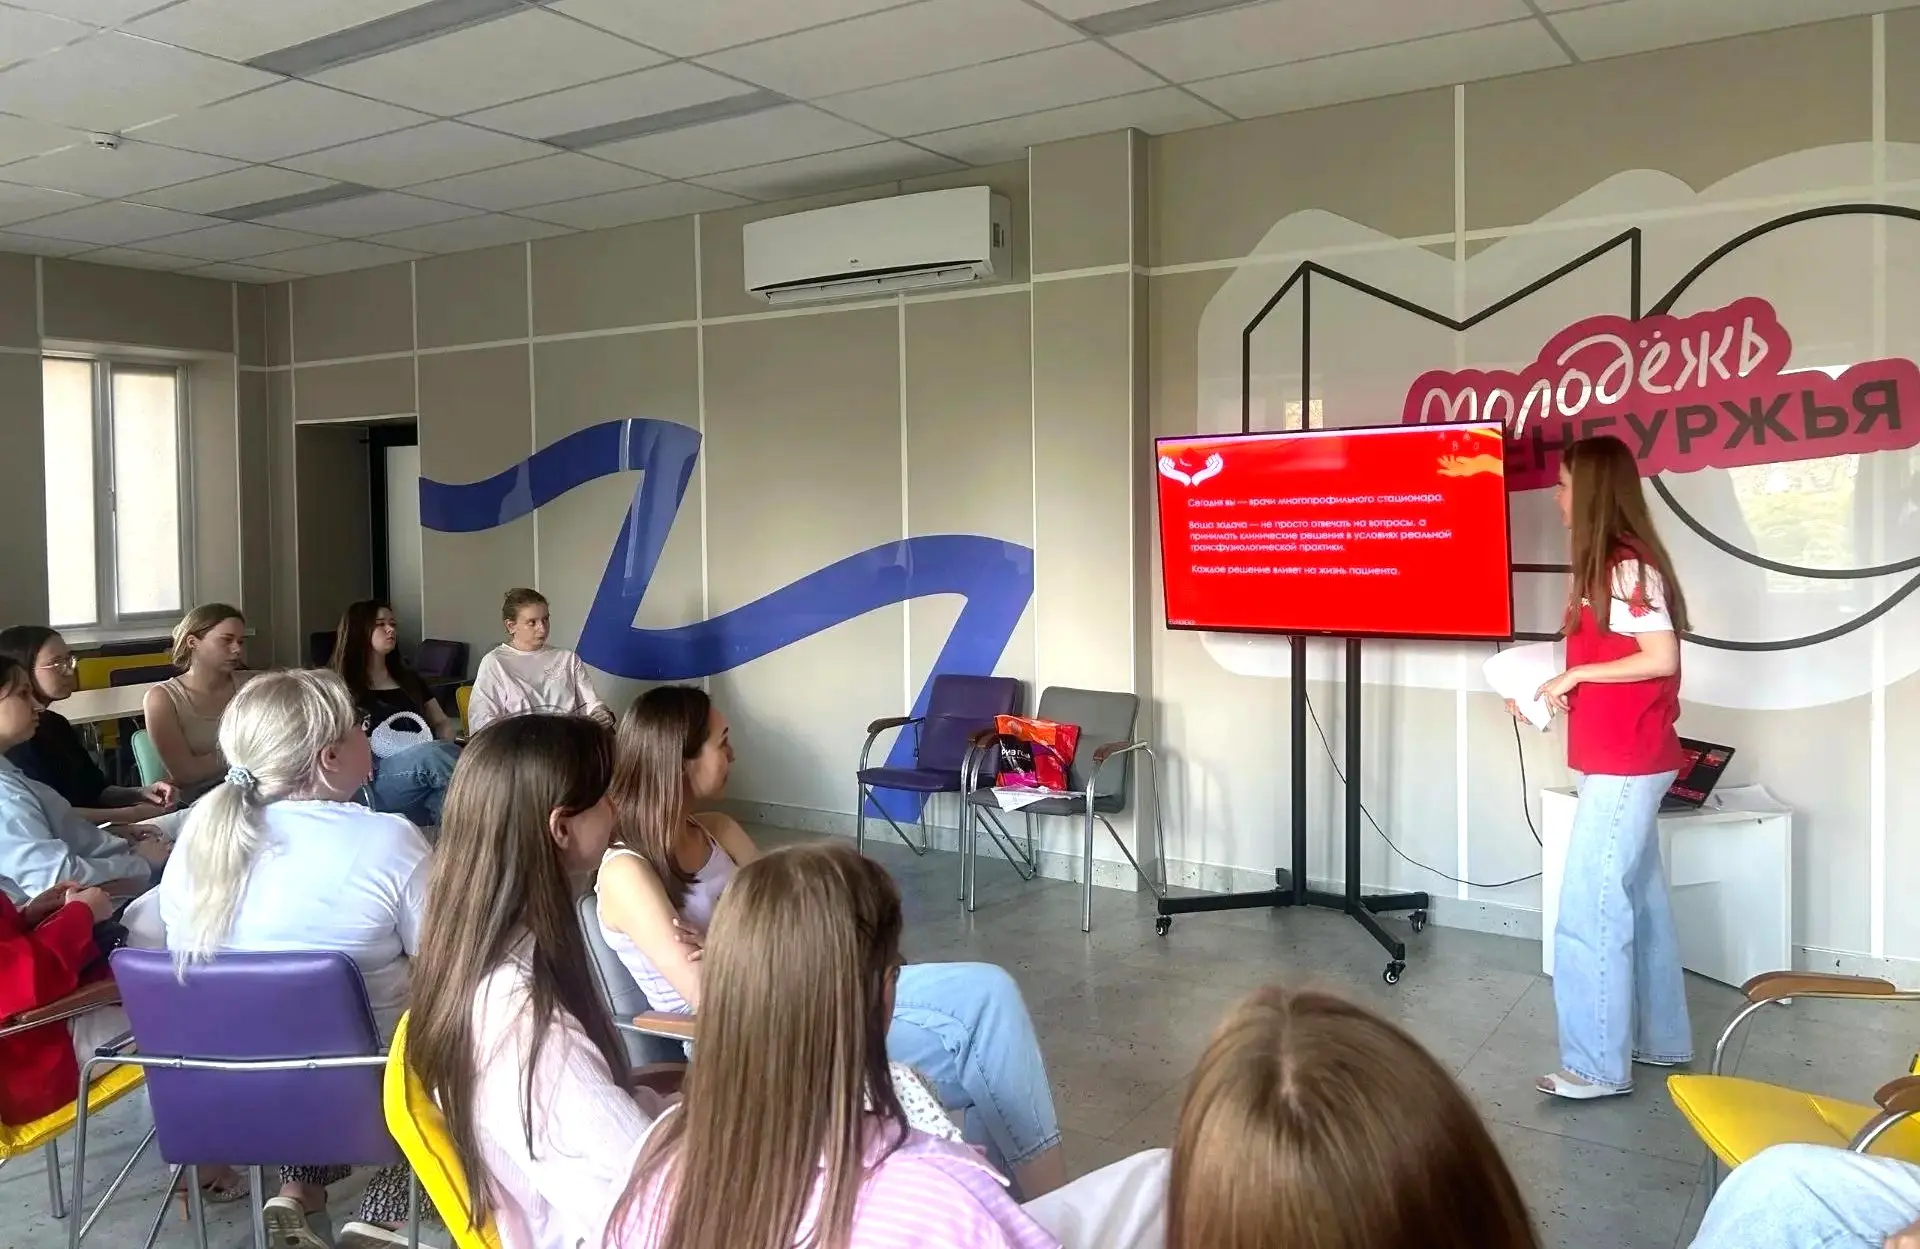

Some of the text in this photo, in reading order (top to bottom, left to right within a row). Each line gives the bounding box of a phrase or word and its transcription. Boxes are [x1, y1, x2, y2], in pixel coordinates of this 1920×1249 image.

[1188, 498, 1224, 508] Сегодня
[1249, 498, 1277, 507] врачи
[1279, 495, 1375, 506] многопрофильного
[1377, 493, 1444, 504] стационара.
[1188, 520, 1215, 529] Ваша
[1216, 521, 1248, 530] задача
[1261, 521, 1272, 529] не
[1275, 520, 1309, 530] просто
[1311, 519, 1351, 528] отвечать
[1354, 519, 1366, 527] на
[1190, 528, 1452, 541] принимать клинические решения в условиях реальной
[1191, 542, 1345, 553] трансфузиологической практики.
[1192, 565, 1226, 574] Каждое
[1228, 566, 1271, 576] решение
[1273, 566, 1301, 574] влияет
[1319, 567, 1347, 575] жизнь
[1349, 566, 1400, 577] пациента.
